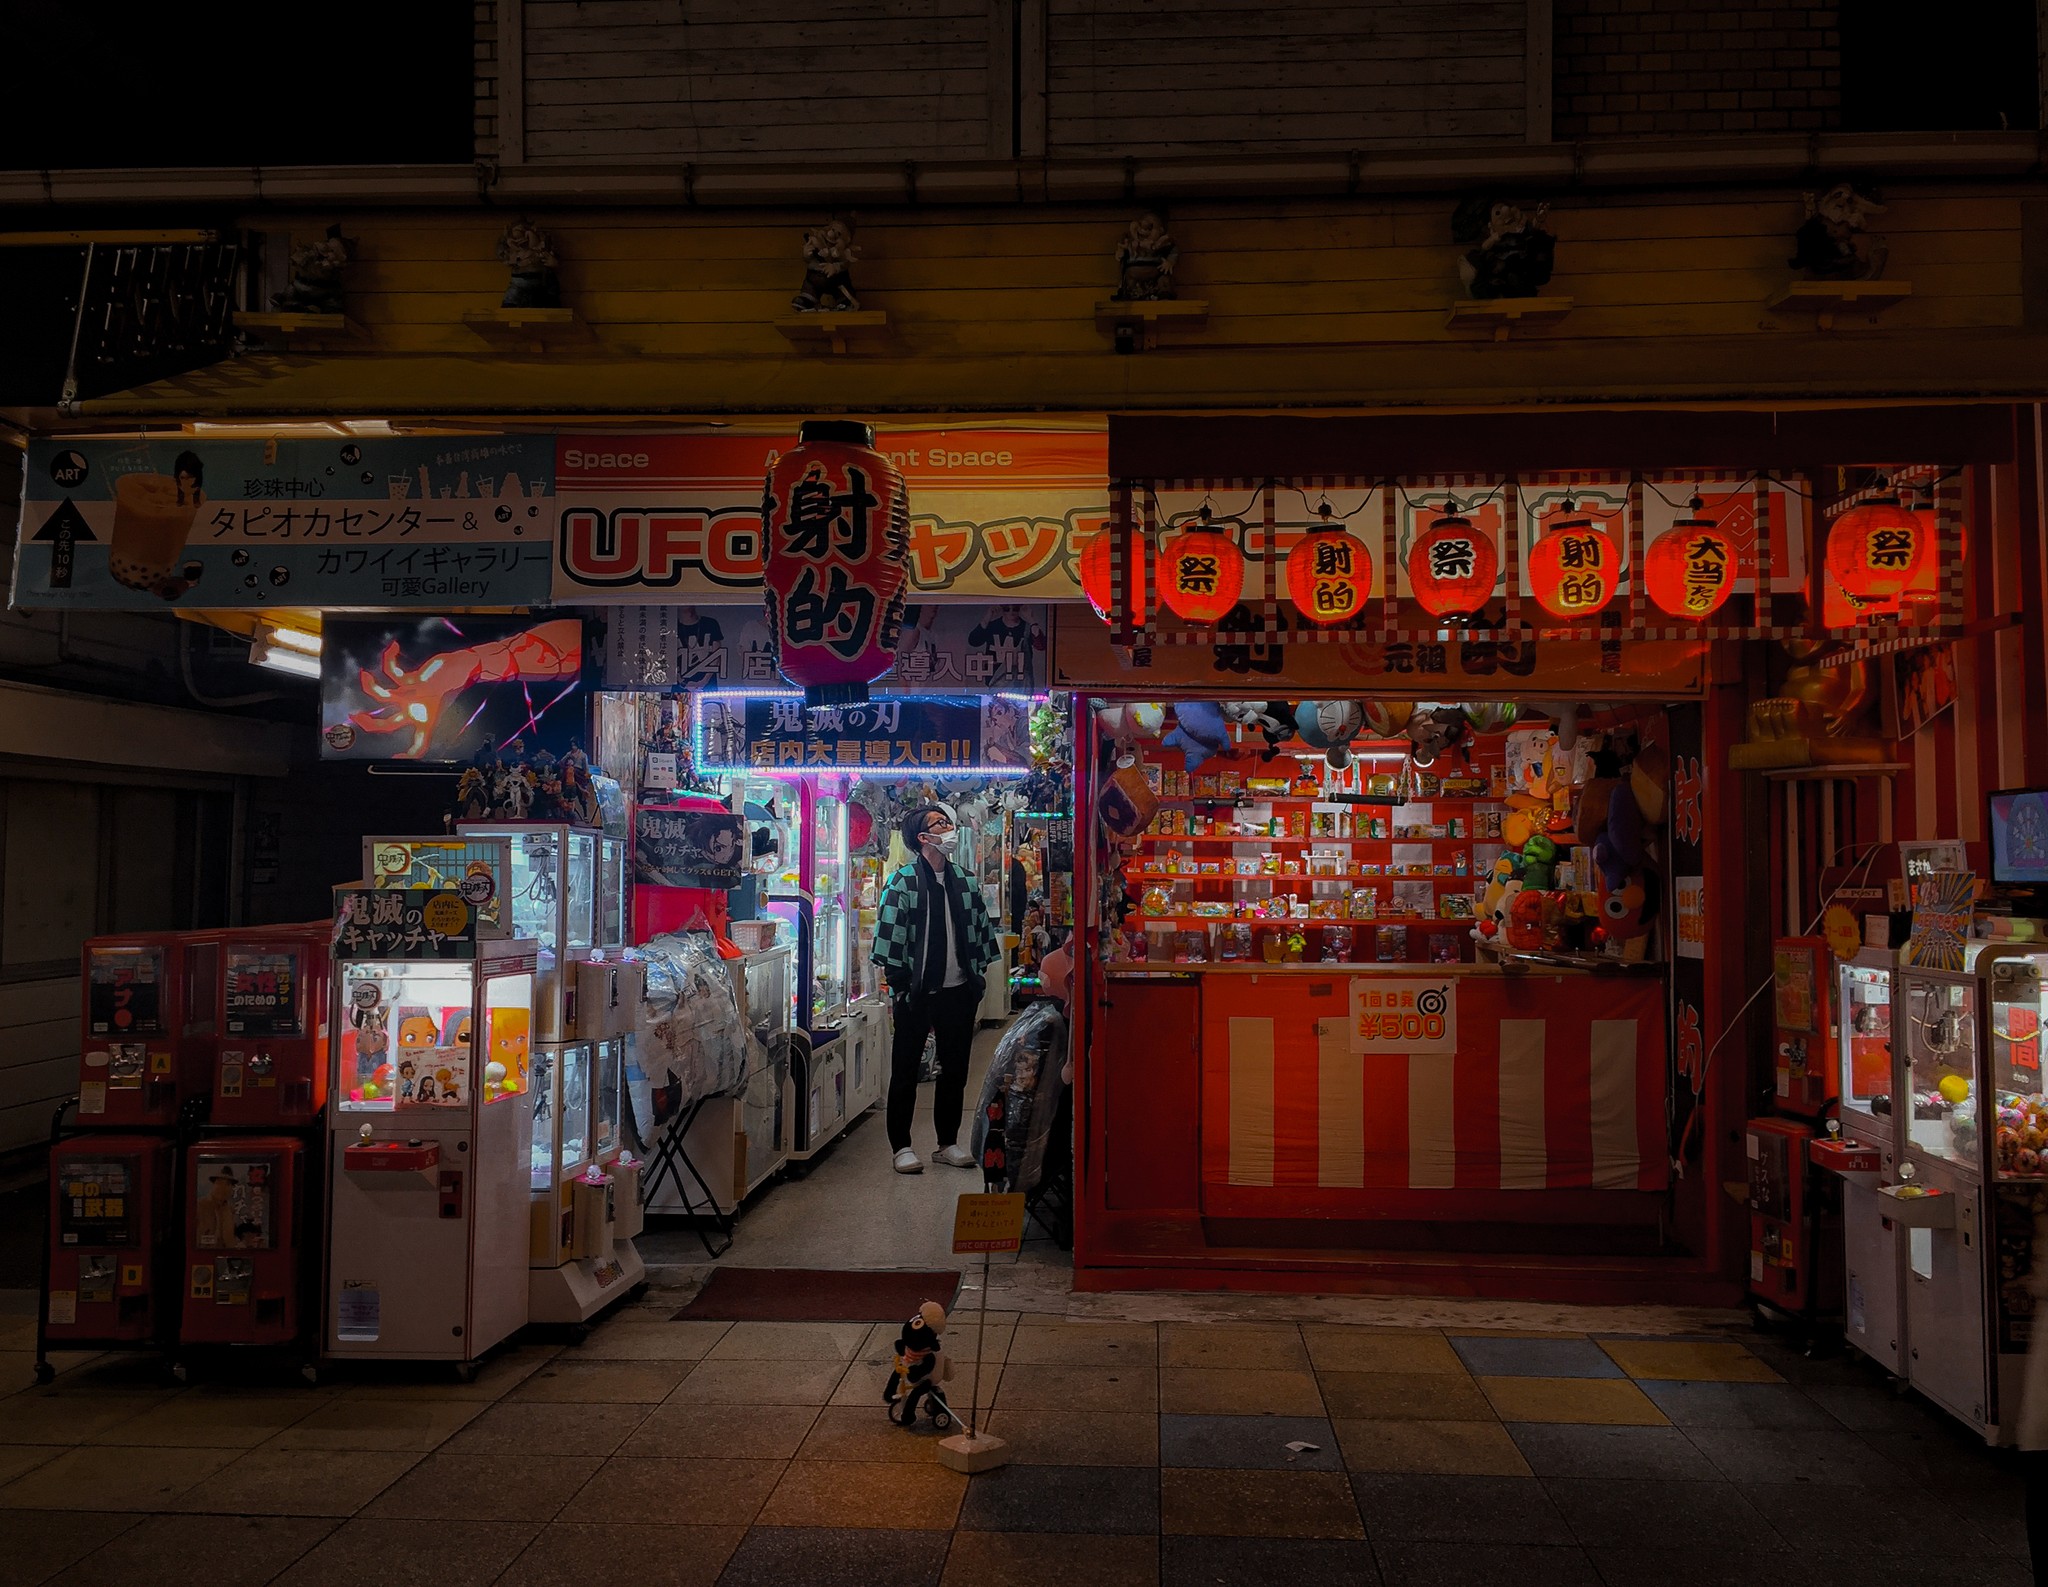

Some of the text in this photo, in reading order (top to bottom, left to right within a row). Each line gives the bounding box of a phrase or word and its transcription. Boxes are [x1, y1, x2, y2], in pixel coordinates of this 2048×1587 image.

[564, 449, 649, 470] Space
[928, 447, 1012, 468] Space
[55, 468, 80, 481] ART
[243, 478, 325, 499] 珍珠中心
[210, 506, 455, 538] タピオカセンター
[316, 546, 549, 575] カワイイギャラリー
[784, 468, 878, 656] 射的
[1432, 541, 1473, 576] 祭
[1871, 530, 1911, 566] 祭
[1179, 555, 1218, 592] 祭
[1316, 542, 1353, 612] 射的
[1562, 537, 1601, 605] 射的
[1687, 537, 1727, 607] 大当たり
[381, 576, 490, 599] 可愛Gallery
[1384, 644, 1446, 674] 元祖
[772, 700, 902, 734] 鬼滅の刃
[751, 739, 971, 767] 店内大量導入中!!
[1675, 755, 1703, 847] 射
[641, 815, 687, 840] 鬼滅
[343, 893, 423, 926] 鬼滅の
[343, 925, 469, 952] キャッチャー
[1358, 992, 1415, 1008] 1回8発
[1360, 1012, 1446, 1040] ¥500
